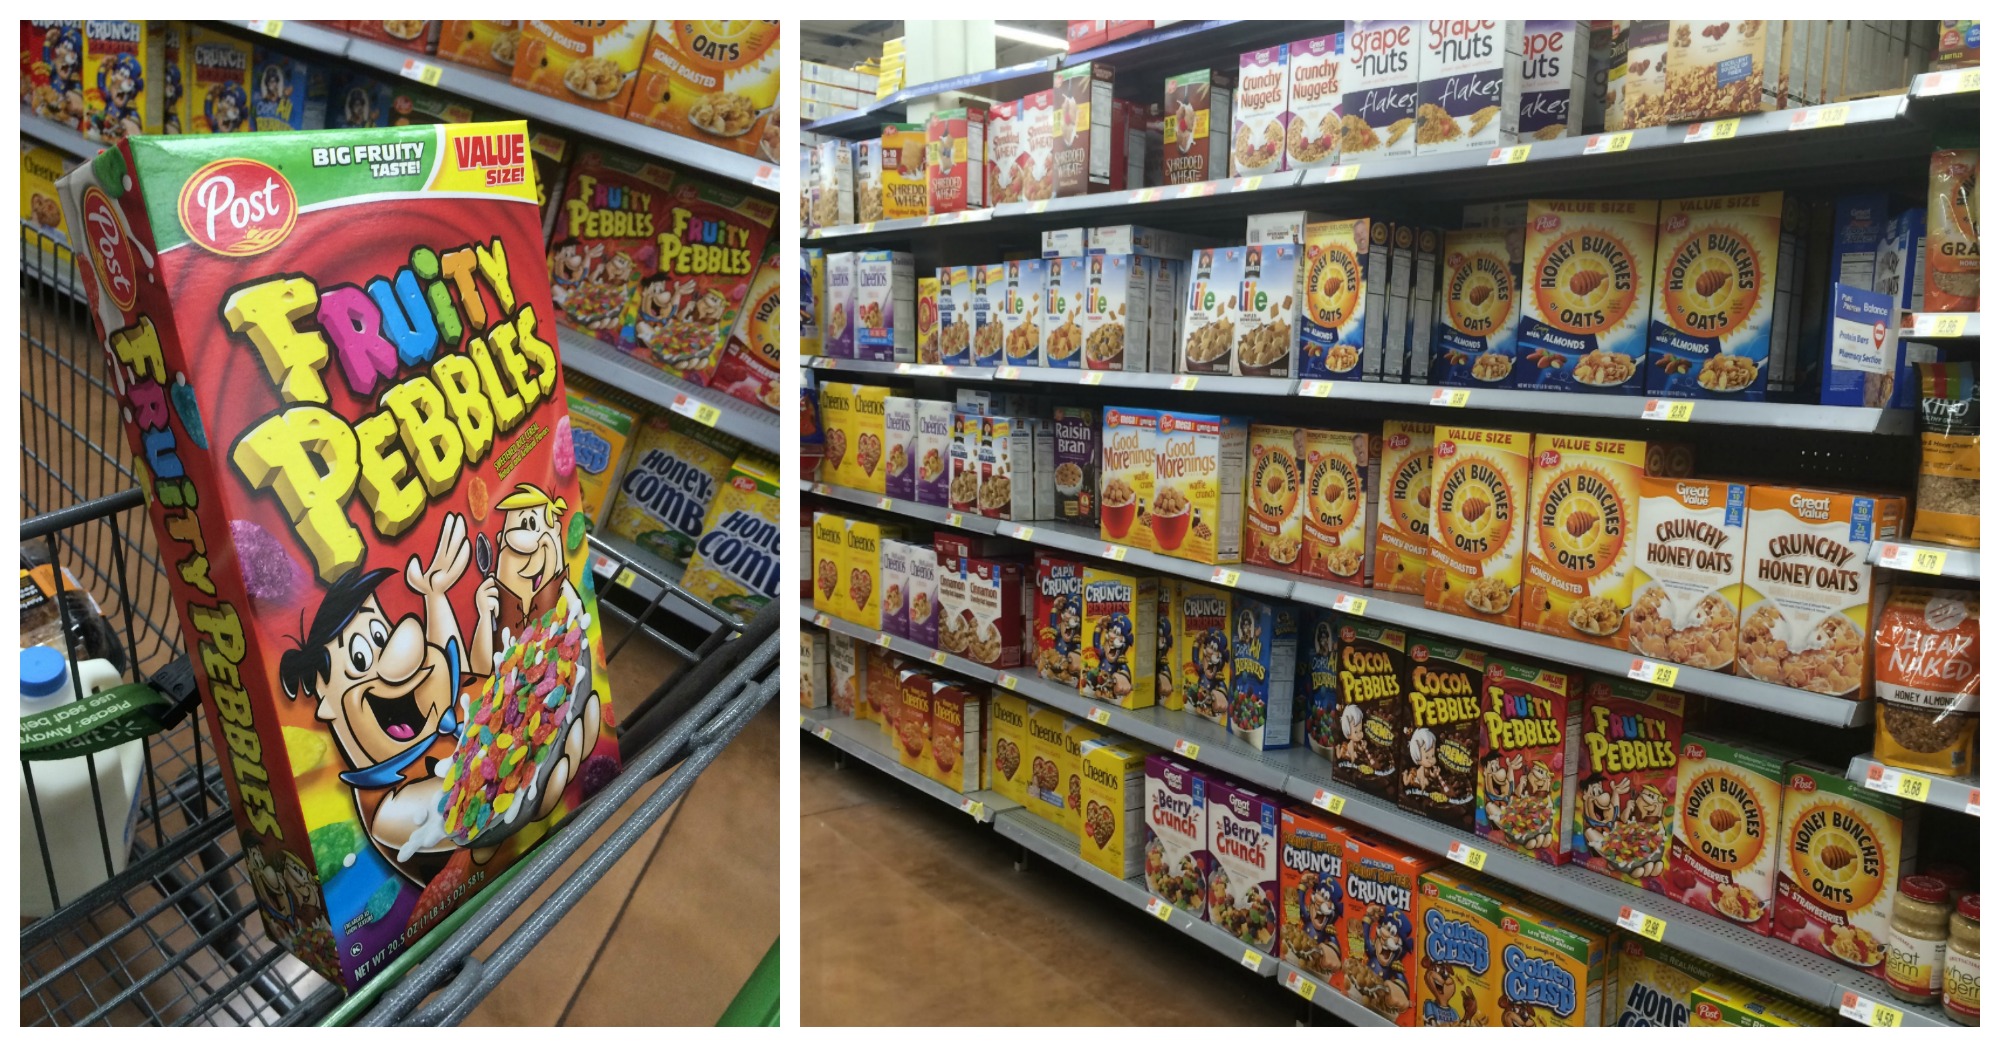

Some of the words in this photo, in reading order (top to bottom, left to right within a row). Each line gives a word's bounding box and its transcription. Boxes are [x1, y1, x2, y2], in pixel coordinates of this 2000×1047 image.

[691, 34, 741, 62] OATS
[1350, 25, 1412, 64] grape
[1434, 31, 1494, 65] -nuts
[677, 64, 717, 89] ROASTED
[1294, 60, 1340, 88] Crunchy
[1355, 49, 1409, 78] -nuts
[1242, 70, 1283, 96] Crunchy
[1292, 79, 1340, 101] Nuggets
[1438, 74, 1503, 105] flakes
[1240, 88, 1283, 110] Nuggets
[1358, 90, 1417, 118] flakes
[312, 146, 351, 168] BIG
[353, 141, 424, 165] FRUITY
[452, 132, 525, 172] VALUE
[370, 160, 421, 178] TASTE!
[485, 166, 526, 188] SIZE!
[196, 175, 281, 242] Post
[1550, 201, 1597, 214] VALUE
[1601, 201, 1636, 214] SIZE
[1679, 197, 1722, 211] VALUE
[1726, 194, 1760, 209] SIZE
[566, 198, 656, 239] PEBBLES
[671, 206, 751, 249] FRUITY
[89, 205, 132, 294] Post
[657, 232, 753, 277] PEBBLES
[1540, 235, 1576, 289] HONEY
[1581, 235, 1631, 292] BUNCHES
[1669, 237, 1702, 290] HONEY
[1708, 233, 1754, 290] BUNCHES
[1310, 254, 1328, 295] HONEY
[1331, 249, 1357, 293] BUNCHES
[1476, 255, 1509, 302] BUNCHES
[1319, 306, 1343, 323] OATS
[1463, 315, 1492, 332] OATS
[1560, 308, 1605, 329] OATS
[1685, 310, 1729, 332] OATS
[1542, 332, 1586, 351] ALMONDS
[1670, 337, 1710, 355] ALMONDS
[230, 303, 558, 586] PEBBLES
[1055, 422, 1092, 441] Raisin
[1057, 437, 1086, 454] Bran
[1112, 429, 1139, 451] Good
[1448, 428, 1483, 443] VALUE
[1485, 431, 1513, 445] SIZE
[1165, 437, 1196, 458] Good
[1438, 442, 1456, 457] Post
[1540, 450, 1560, 466] Post
[1551, 437, 1592, 451] VALUE
[1594, 440, 1626, 455] SIZE
[1156, 453, 1217, 480] Morenings
[1255, 454, 1271, 488] HONEY
[1272, 451, 1296, 492] BUNCHES
[1311, 461, 1328, 497] HONEY
[1330, 456, 1357, 502] BUNCHES
[1394, 456, 1422, 500] HONEY
[1441, 466, 1468, 512] HONEY
[1470, 464, 1509, 521] BUNCHES
[1676, 482, 1711, 499] Great
[1683, 493, 1709, 507] Value
[1790, 494, 1831, 512] Great
[1263, 503, 1284, 517] OATS
[1320, 512, 1344, 527] OATS
[1542, 477, 1572, 527] HONEY
[1576, 475, 1620, 536] BUNCHES
[1798, 505, 1830, 521] Value
[1454, 533, 1488, 554] OATS
[1656, 518, 1729, 551] CRUNCHY
[1557, 549, 1596, 572] OATS
[1647, 542, 1693, 566] HONEY
[1696, 550, 1732, 574] OATS
[1768, 533, 1855, 569] CRUNCHY
[1917, 553, 1936, 569] $4.78
[1448, 556, 1478, 576] ROASTED
[1758, 559, 1812, 587] HONEY
[1815, 568, 1859, 594] OATS
[1085, 583, 1132, 603] CRUNCH
[1551, 573, 1583, 594] ROASTED
[1086, 600, 1131, 616] BERRIES
[1183, 598, 1227, 618] CRUNCH
[1341, 645, 1394, 674] COCOA
[1888, 649, 1973, 681] NAKED
[1340, 670, 1401, 704] PEBBLES
[1412, 664, 1473, 697] COCOA
[89, 692, 117, 708] use
[1408, 691, 1481, 728] PEBBLES
[1894, 689, 1921, 702] HONEY
[52, 704, 88, 724] seat
[75, 699, 132, 728] Please:
[187, 600, 285, 842] PEBBLES
[1484, 712, 1562, 751] PEBBLES
[1584, 732, 1677, 774] PEBBLES
[1685, 746, 1705, 760] Post
[1082, 758, 1118, 790] Cheerios
[1793, 777, 1814, 791] Post
[1228, 793, 1250, 809] Great
[1902, 780, 1922, 797] $3.68
[1157, 788, 1192, 818] Berry
[1688, 778, 1716, 818] HONEY
[1719, 776, 1760, 839] BUNCHES
[1152, 805, 1198, 839] Crunch
[1222, 815, 1260, 846] Berry
[1216, 836, 1266, 870] Crunch
[1701, 840, 1737, 864] OATS
[1832, 811, 1879, 879] BUNCHES
[1283, 846, 1343, 878] CRUNCH
[1683, 855, 1729, 886] STRAWBERRIES
[1347, 875, 1412, 911] CRUNCH
[1812, 877, 1854, 905] OATS
[1791, 890, 1844, 925] STRAWBERRIES
[353, 963, 371, 982] NET
[371, 951, 386, 967] WT
[387, 933, 406, 956] 20.5
[406, 923, 418, 938] OZ
[428, 906, 439, 921] LB
[467, 871, 486, 889] 581g
[1426, 908, 1489, 949] Golden
[1504, 943, 1575, 989] Golden
[1669, 955, 1688, 970] REAL
[1699, 1004, 1719, 1020] Post
